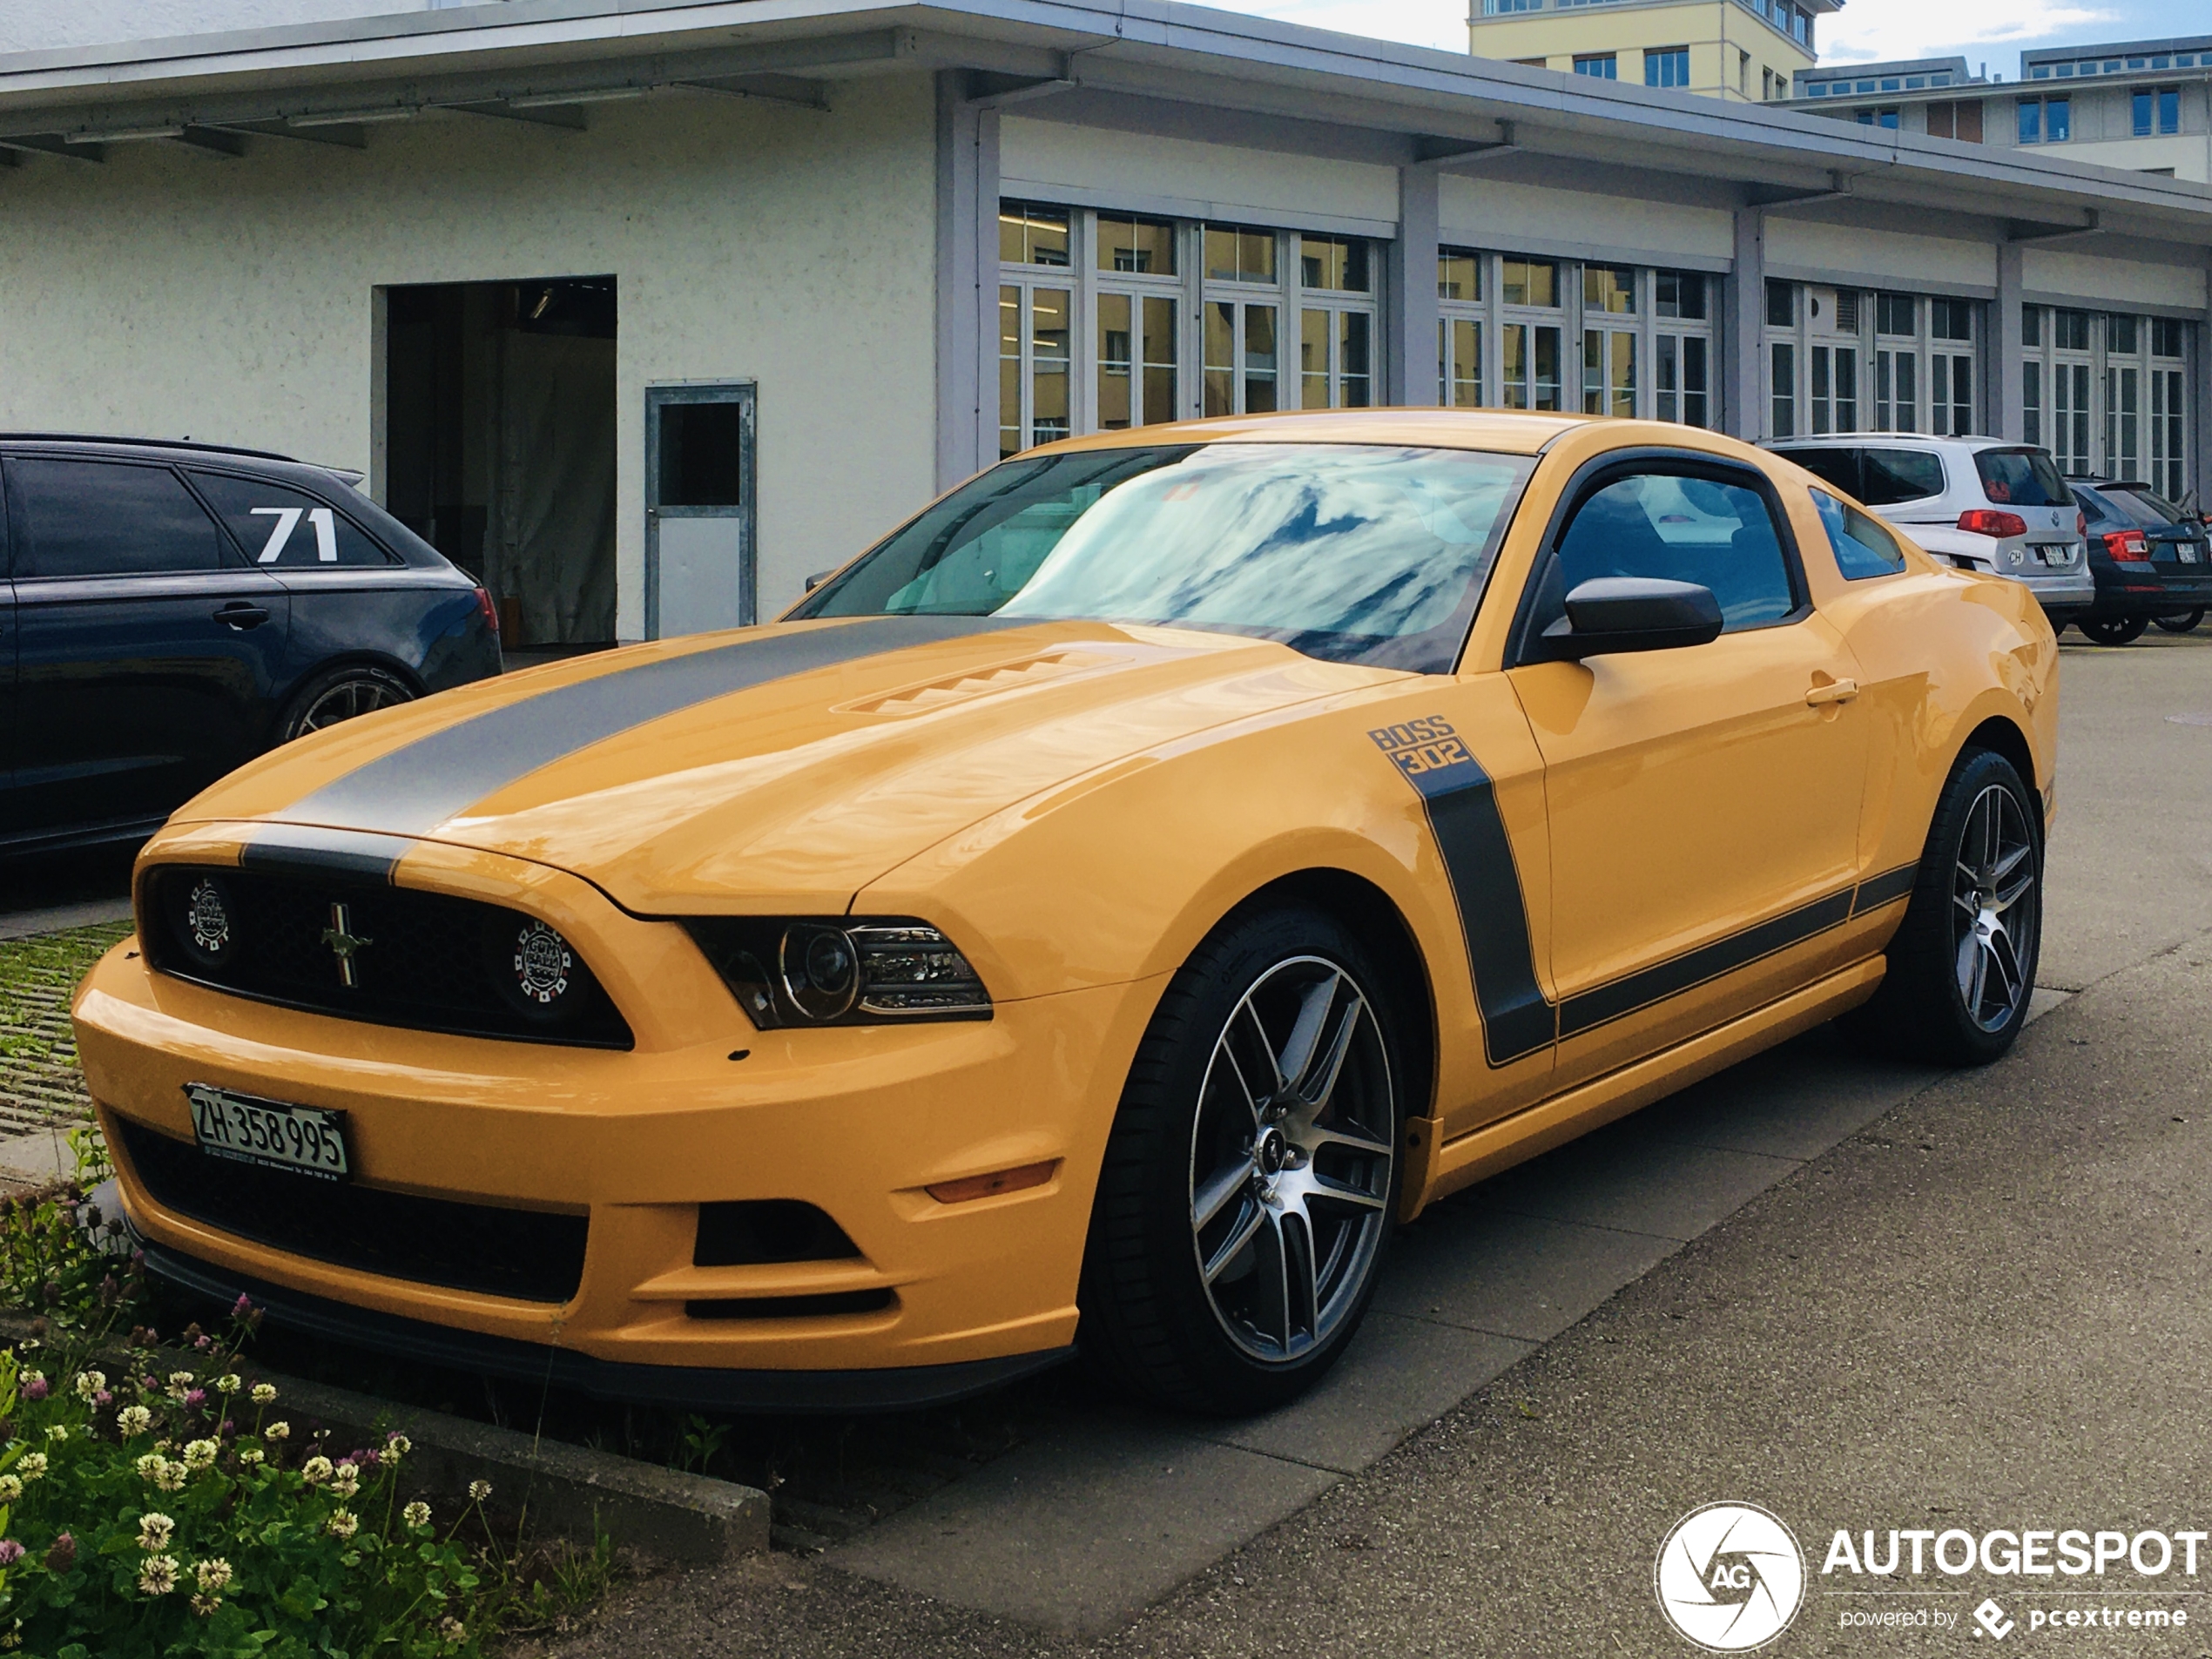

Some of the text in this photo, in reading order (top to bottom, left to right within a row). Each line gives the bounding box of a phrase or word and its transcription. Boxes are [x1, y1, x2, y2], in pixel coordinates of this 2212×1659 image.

[250, 507, 338, 563] 71
[2009, 551, 2021, 563] CH
[1366, 714, 1456, 752] BOSS
[1396, 738, 1470, 775] 302
